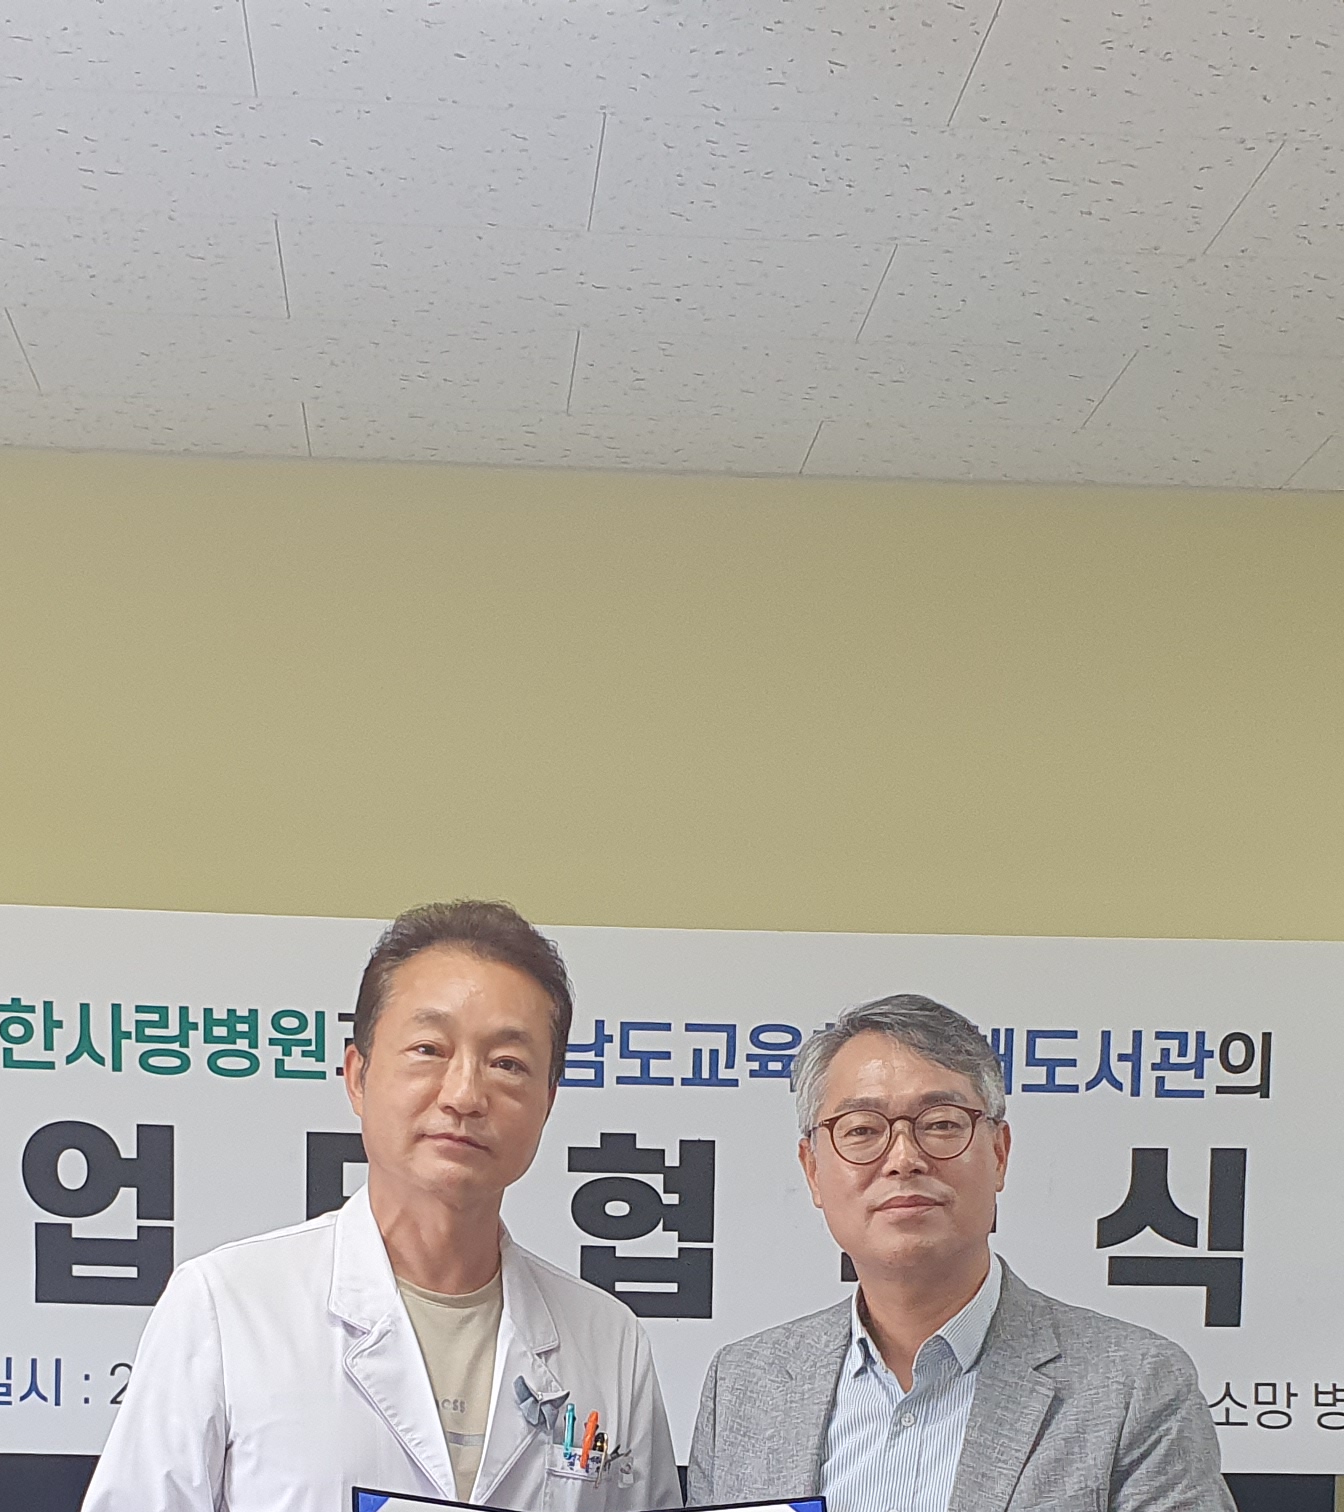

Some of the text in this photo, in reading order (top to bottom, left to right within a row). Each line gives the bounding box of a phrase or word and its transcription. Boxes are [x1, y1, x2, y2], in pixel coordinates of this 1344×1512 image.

[558, 1018, 832, 1093] 남도교육
[436, 1398, 466, 1414] OSS
[1206, 1381, 1299, 1430] 소망
